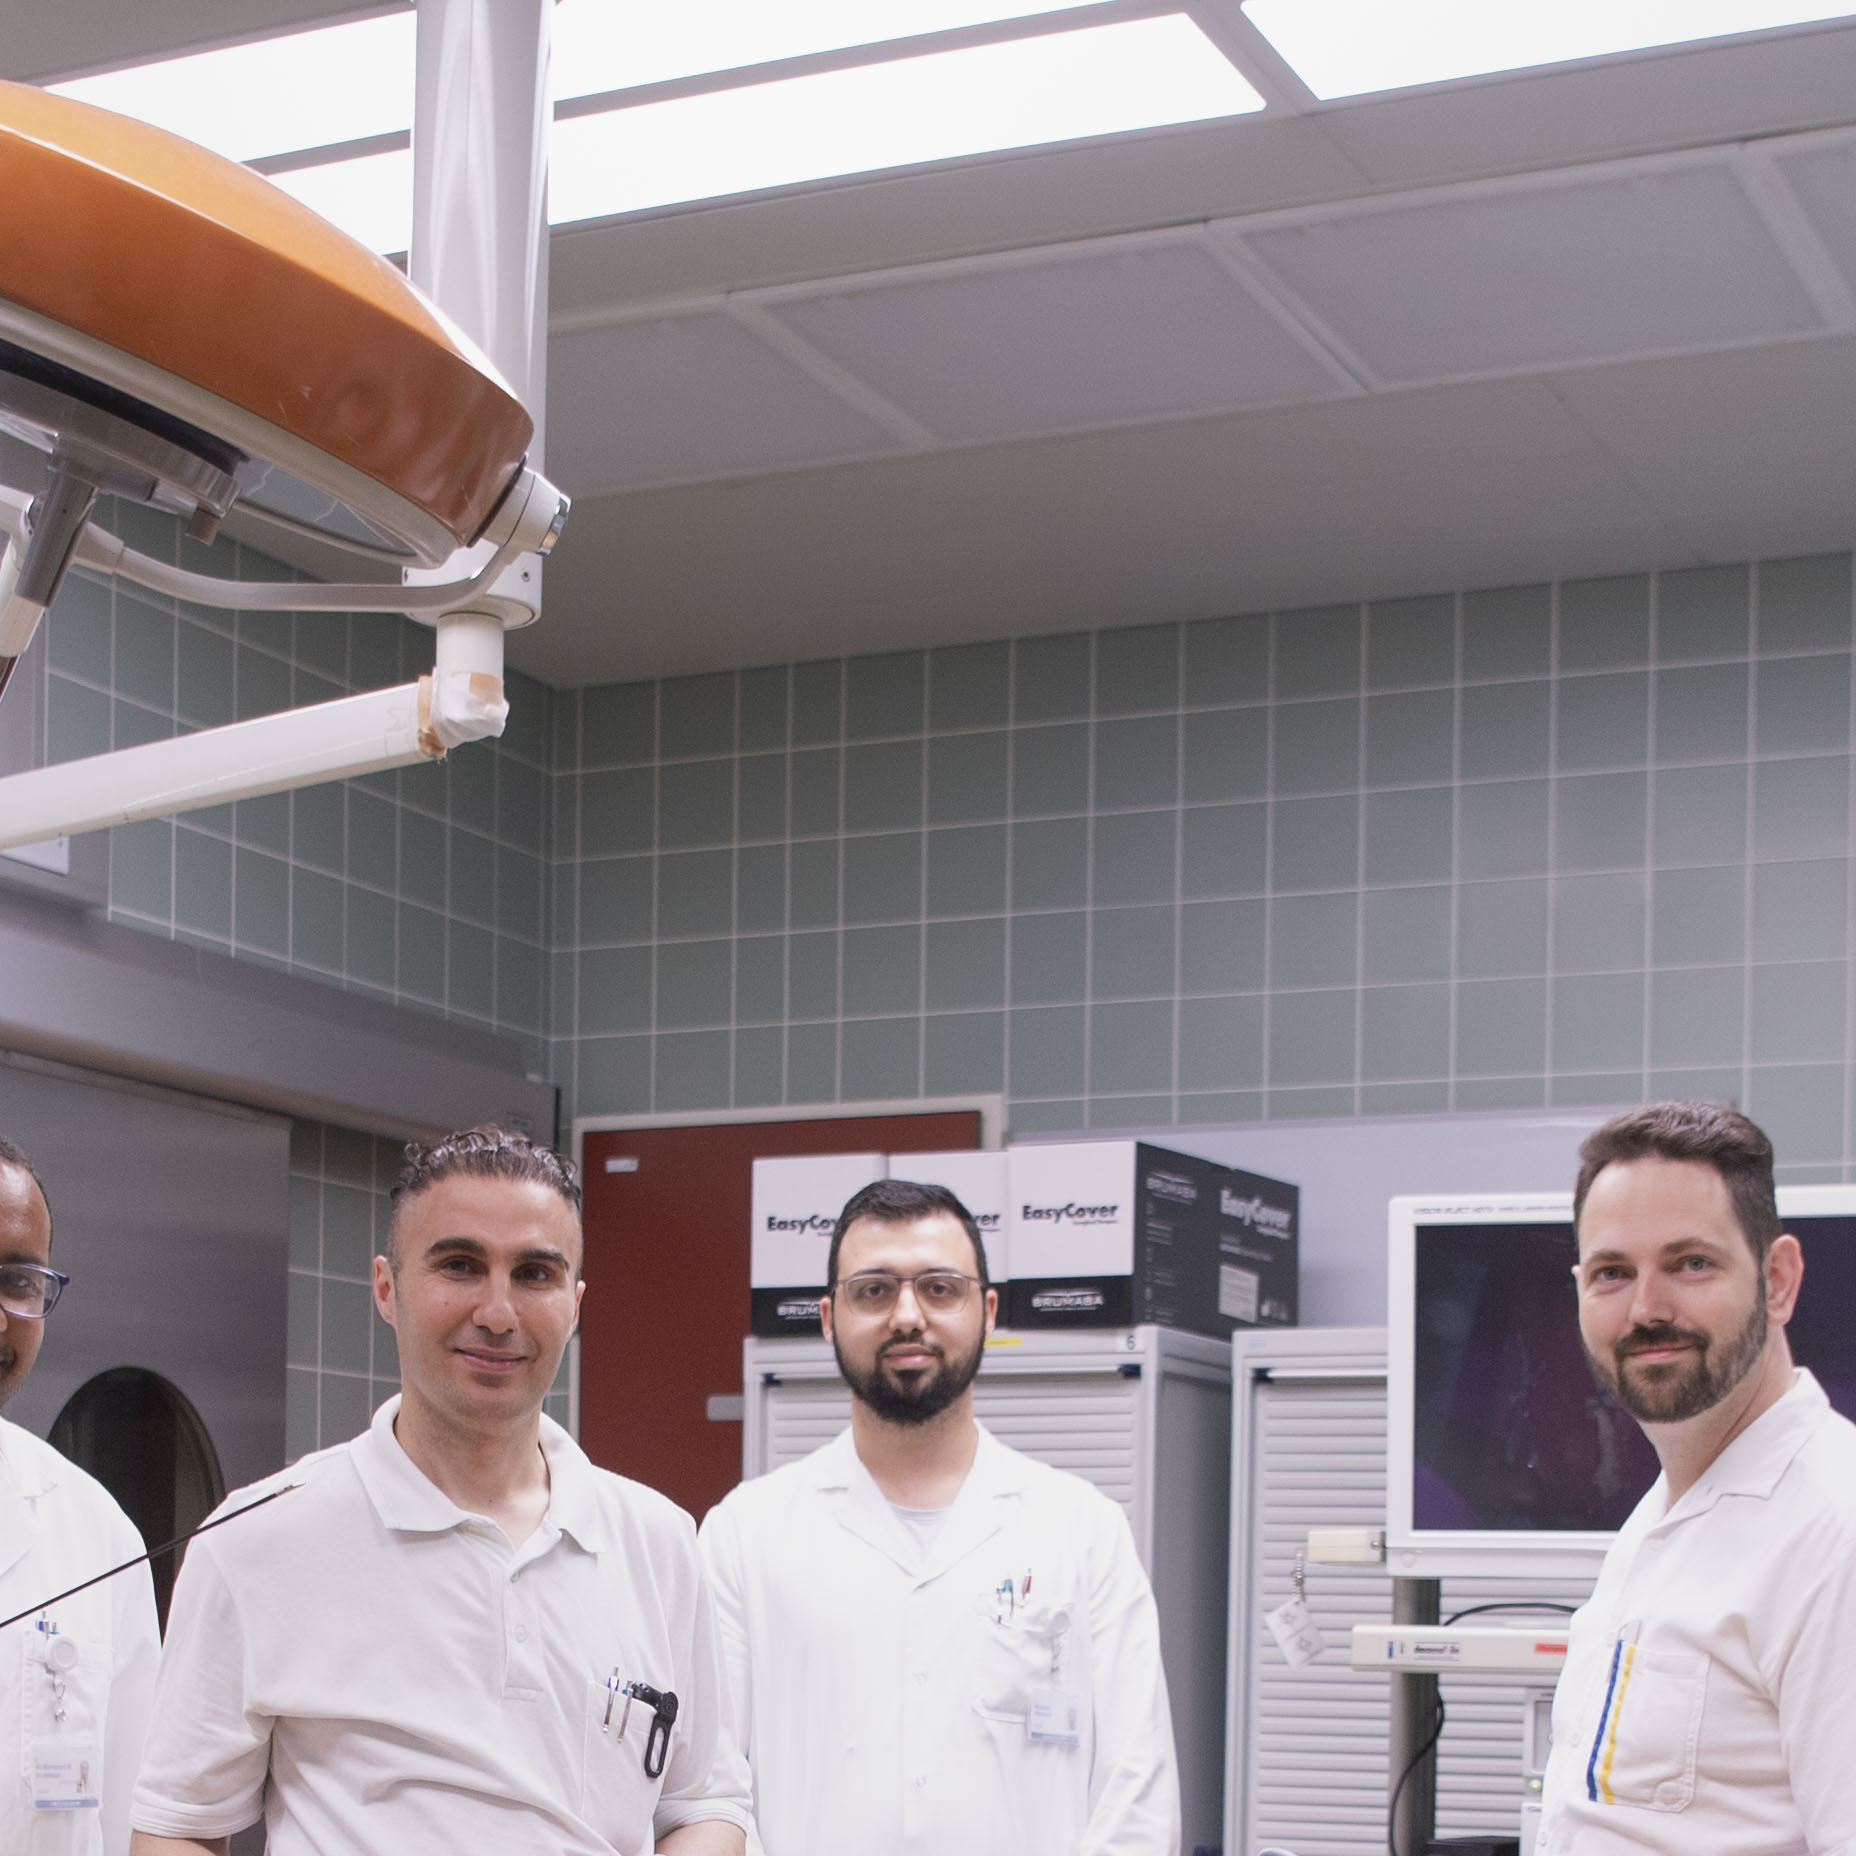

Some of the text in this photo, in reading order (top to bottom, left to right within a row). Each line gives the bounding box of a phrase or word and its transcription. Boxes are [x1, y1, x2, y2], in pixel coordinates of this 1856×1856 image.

[1023, 1203, 1118, 1223] EasyCover
[777, 1303, 820, 1317] BRUM
[1126, 1335, 1136, 1350] 6
